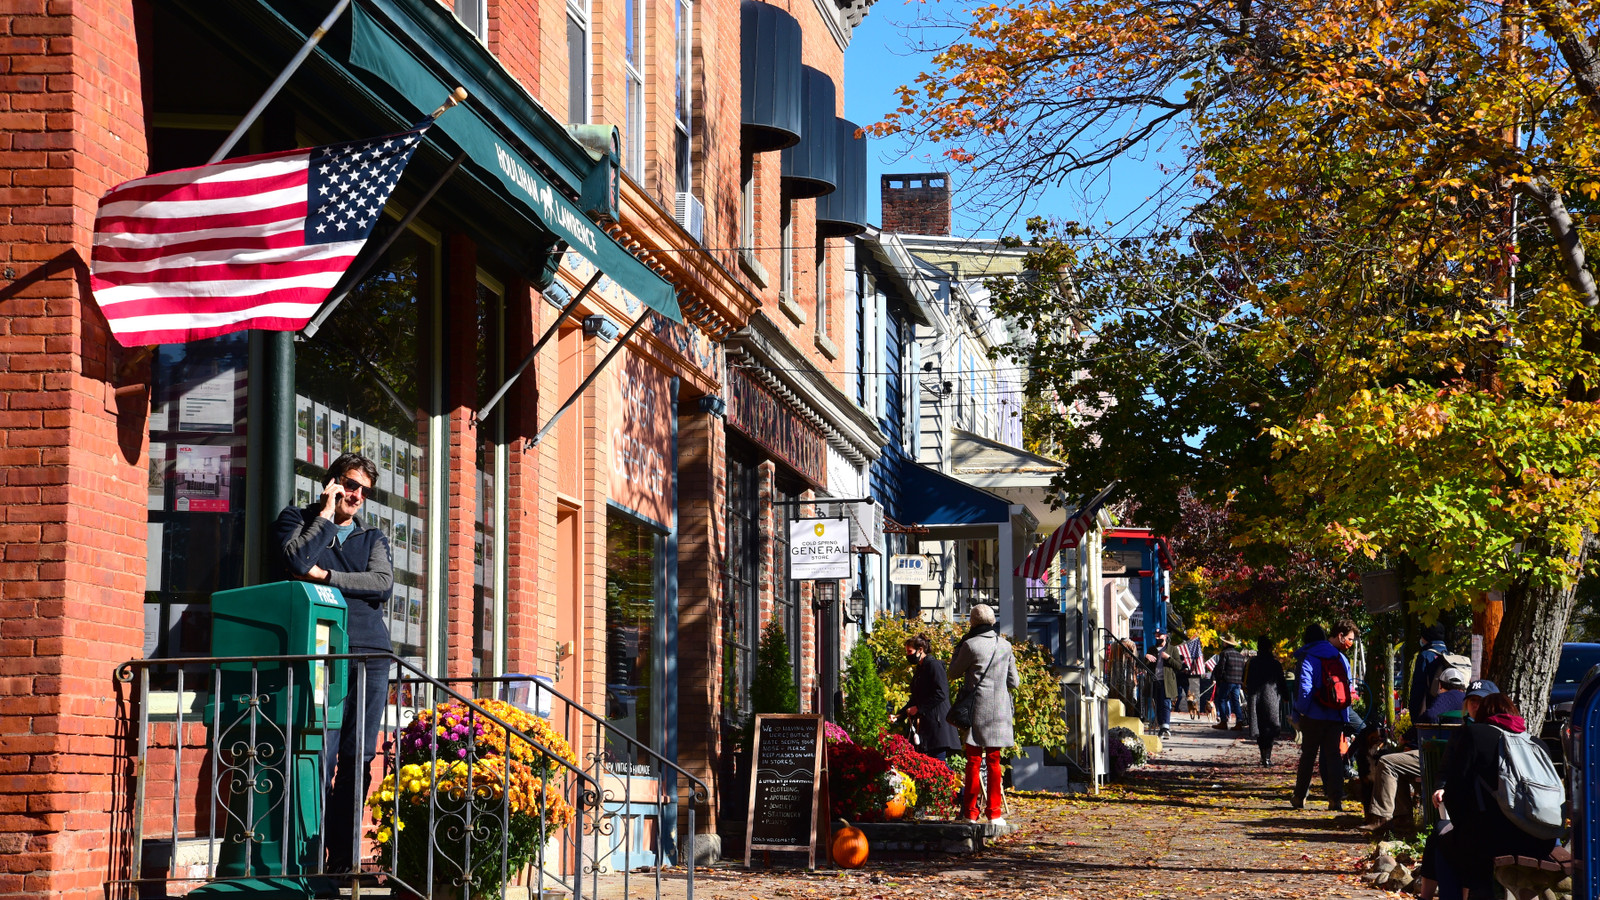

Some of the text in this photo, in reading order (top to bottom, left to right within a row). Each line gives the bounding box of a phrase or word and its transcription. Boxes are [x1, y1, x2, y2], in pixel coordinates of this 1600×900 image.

[495, 142, 597, 255] HOULIHAN LAWRENCE
[612, 427, 664, 497] GEORGE
[791, 546, 848, 555] GENERAL
[314, 584, 339, 605] FREE
